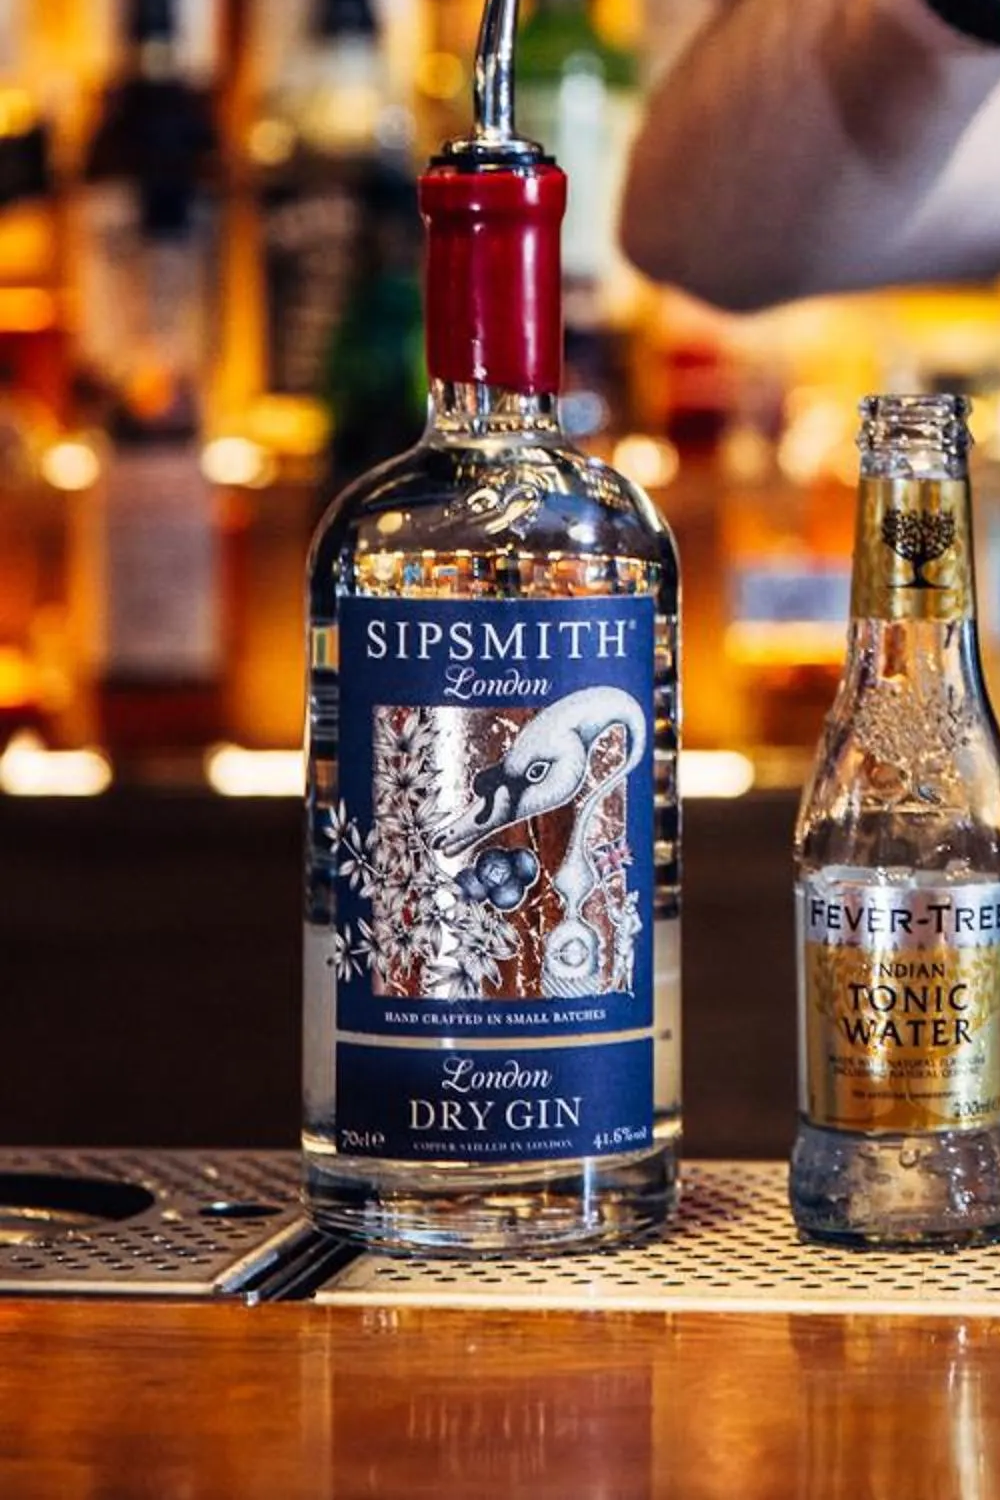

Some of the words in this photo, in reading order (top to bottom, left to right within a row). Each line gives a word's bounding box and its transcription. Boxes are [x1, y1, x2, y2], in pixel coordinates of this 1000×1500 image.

[443, 665, 551, 700] London
[872, 962, 945, 979] NDIAN
[848, 984, 968, 1012] TONIC
[385, 1011, 419, 1024] HAND
[422, 1013, 483, 1026] CRAFTED
[488, 1014, 502, 1026] IN
[505, 1011, 550, 1025] SMALL
[553, 1008, 606, 1024] BATCHES
[843, 1018, 971, 1047] WATER
[441, 1057, 552, 1093] London
[409, 1100, 494, 1130] DRY
[505, 1098, 582, 1130] GIN
